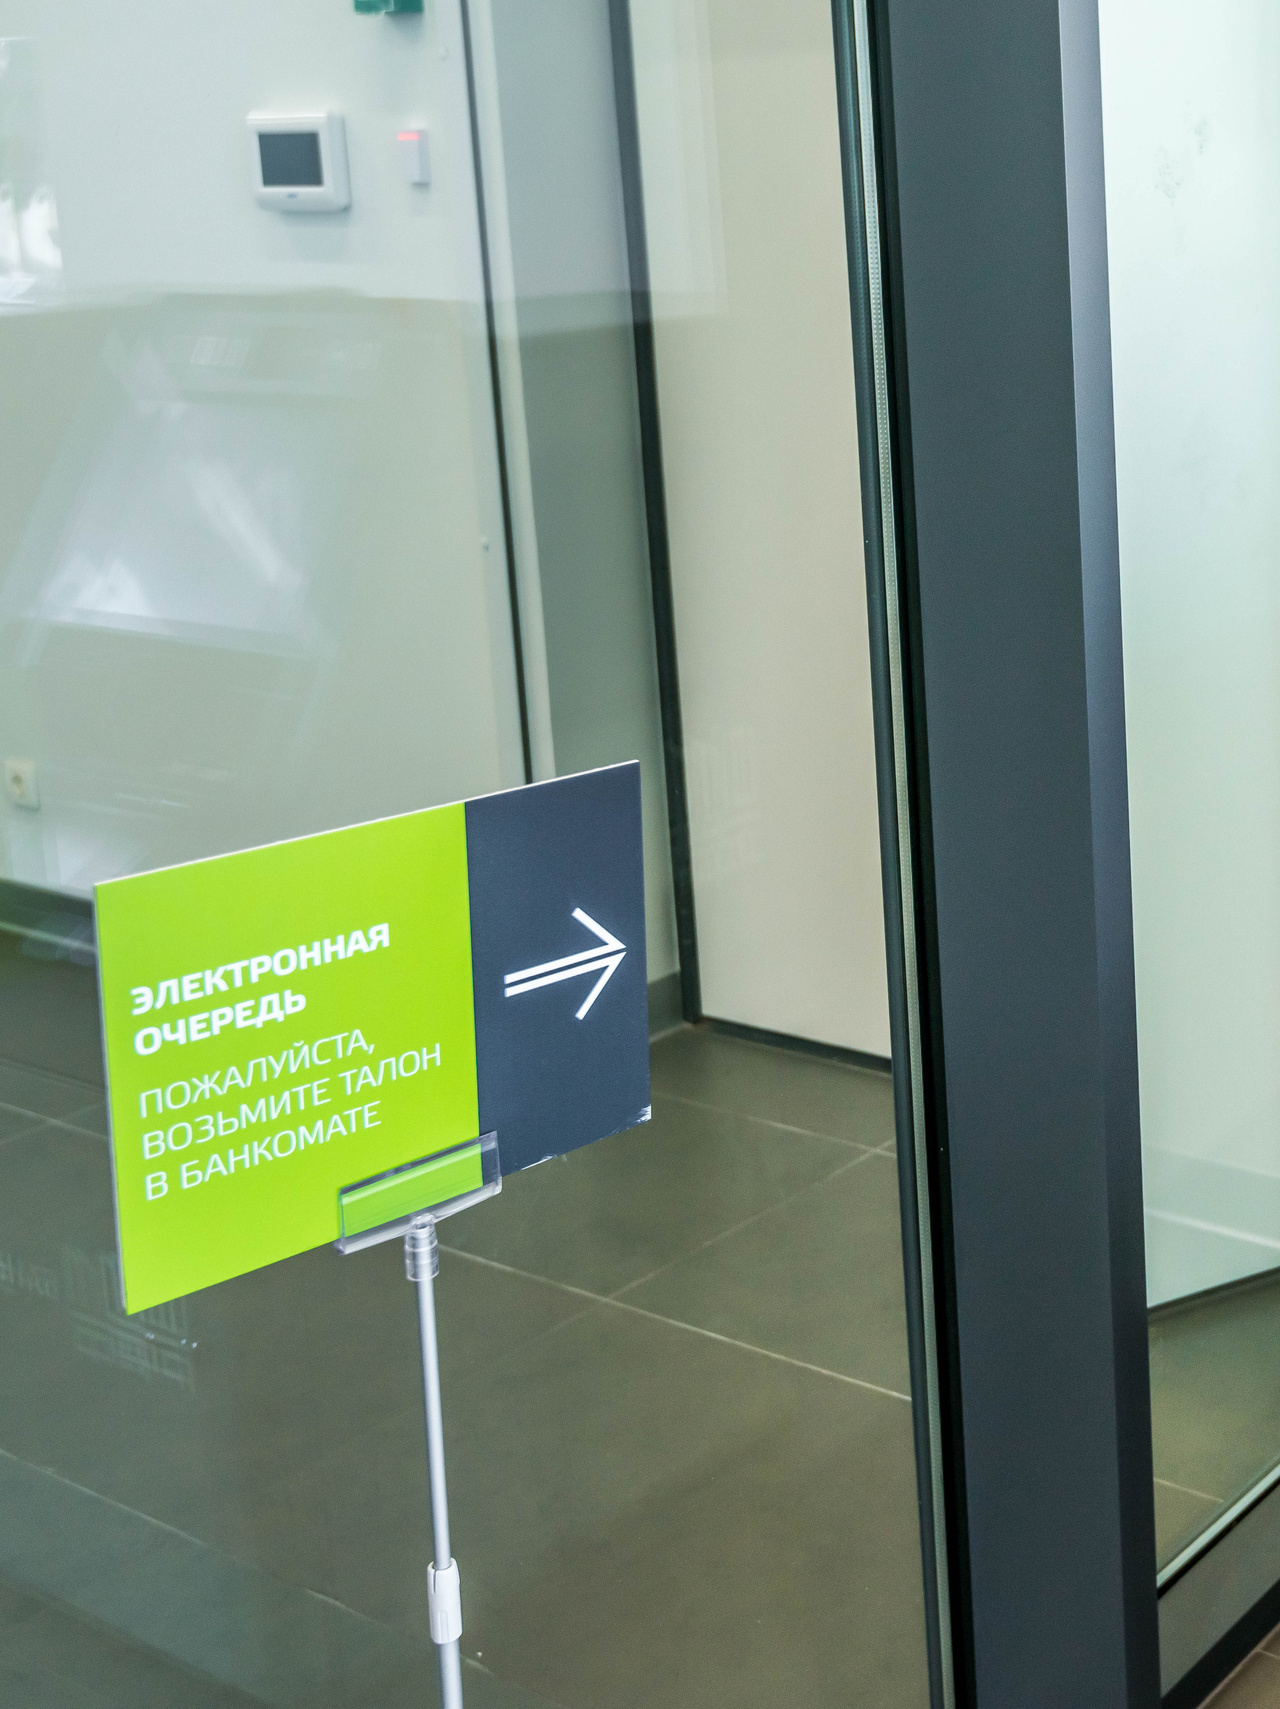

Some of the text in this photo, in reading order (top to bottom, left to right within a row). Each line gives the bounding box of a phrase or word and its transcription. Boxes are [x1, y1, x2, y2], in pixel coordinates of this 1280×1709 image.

[130, 922, 391, 1015] ЭЛЕКТРОННАЯ
[133, 988, 307, 1056] ОЧЕРЕДЬ
[139, 1027, 376, 1119] ПОЖАЛУЙСТА,
[142, 1043, 442, 1160] ВОЗЬМИТЕ ТАЛОН
[145, 1101, 382, 1201] В БАНКОМАТЕ
